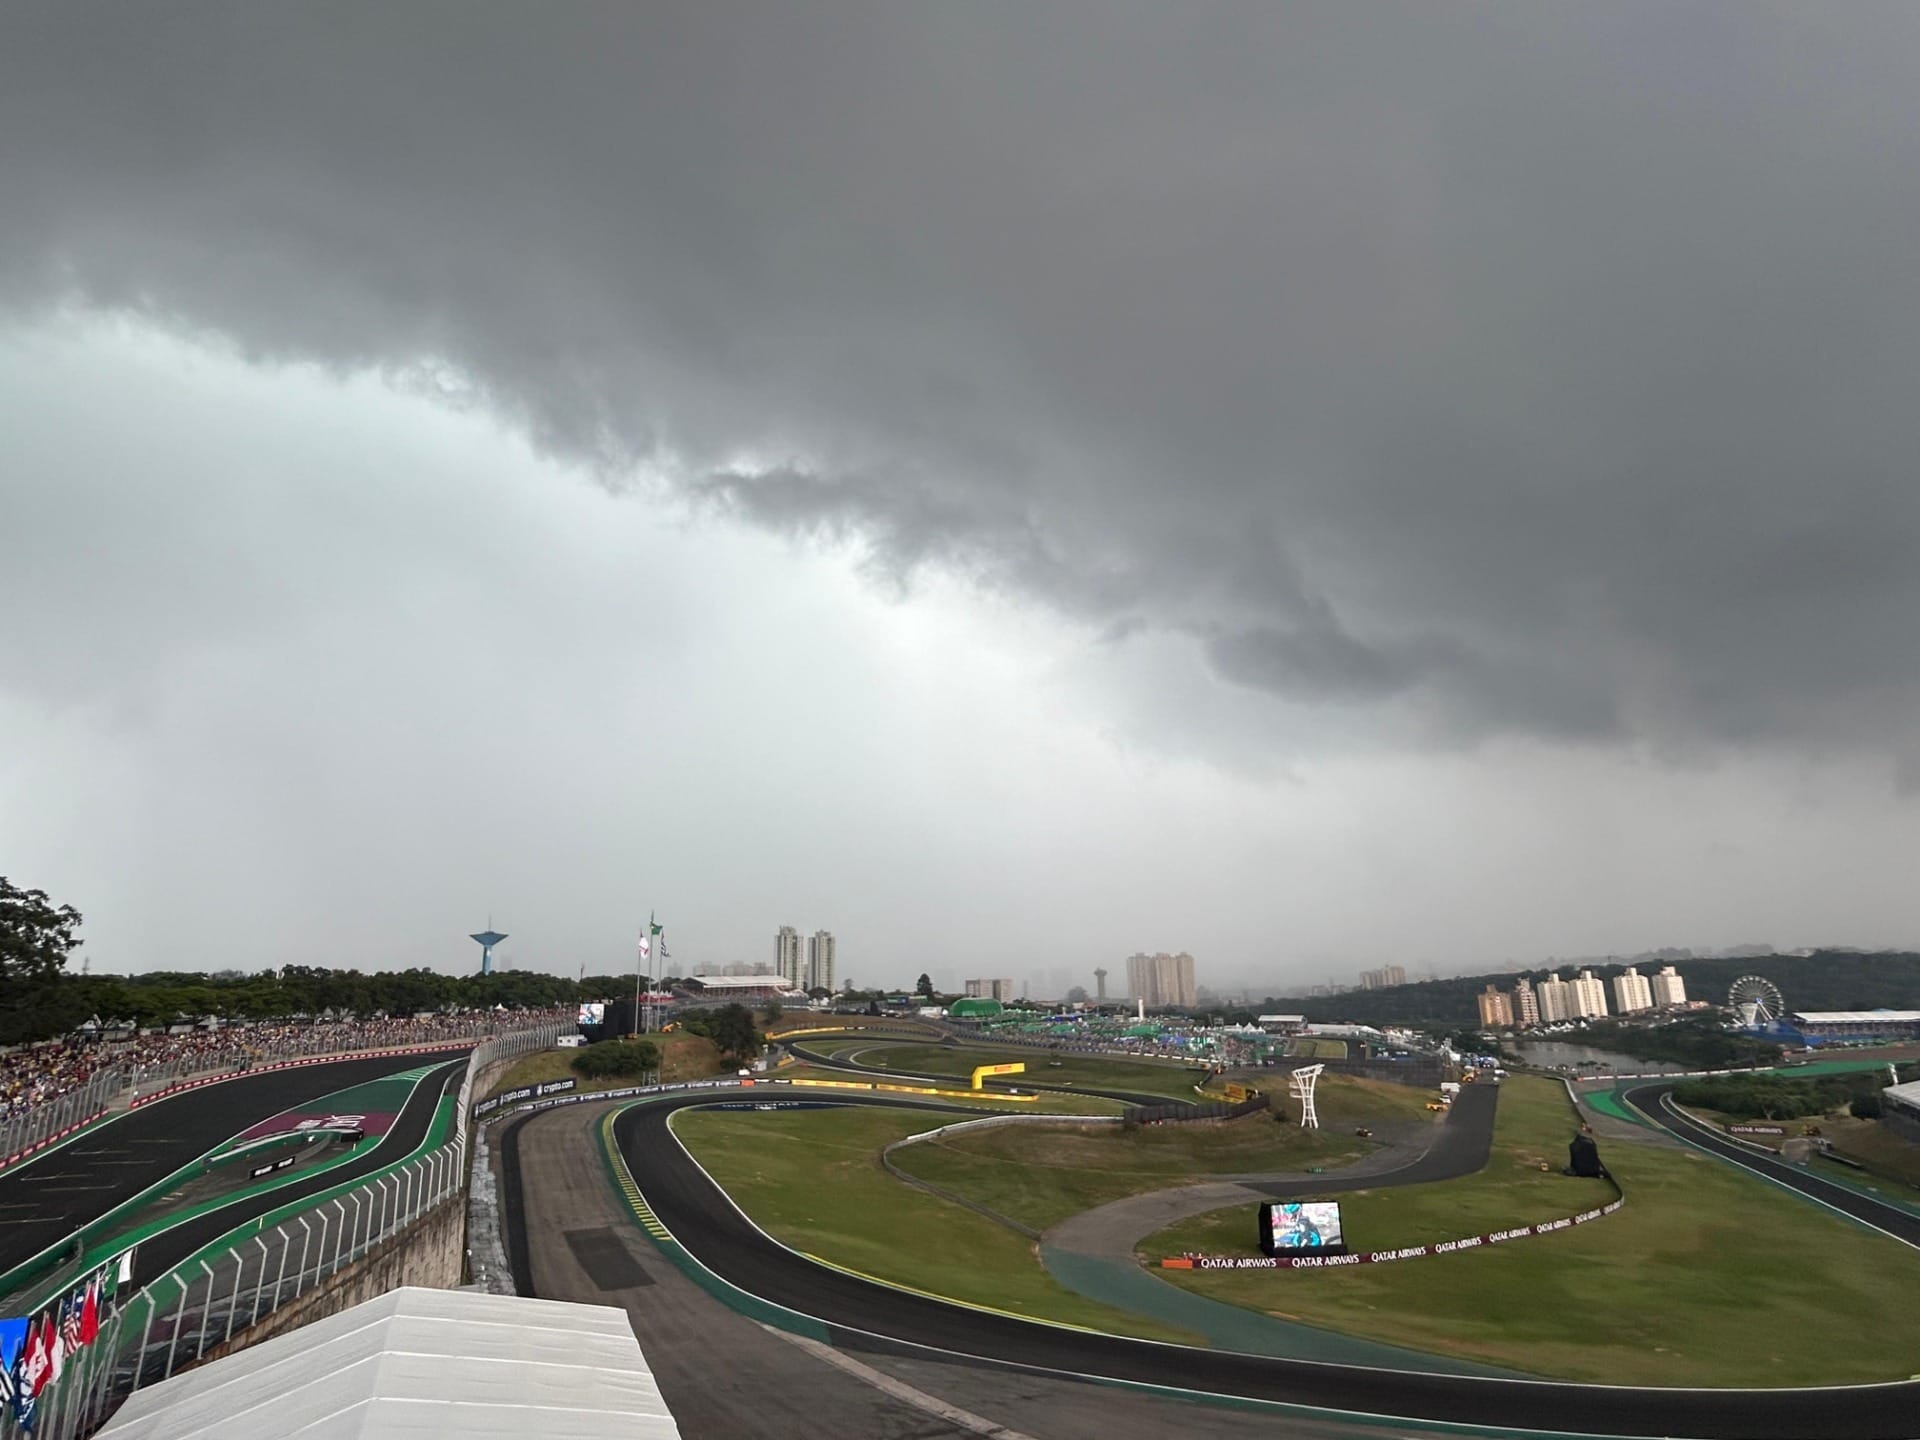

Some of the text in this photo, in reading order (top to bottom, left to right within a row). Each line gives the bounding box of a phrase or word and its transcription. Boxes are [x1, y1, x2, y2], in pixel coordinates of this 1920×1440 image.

[543, 1080, 574, 1093] crypto.com
[1435, 1236, 1482, 1254] QATAR AIRWAYS
[1292, 1254, 1360, 1268] QATAR AIRWAYS
[1371, 1246, 1427, 1263] QATAR AIRWAYS
[1200, 1257, 1277, 1269] QATAR AIRWAYS
